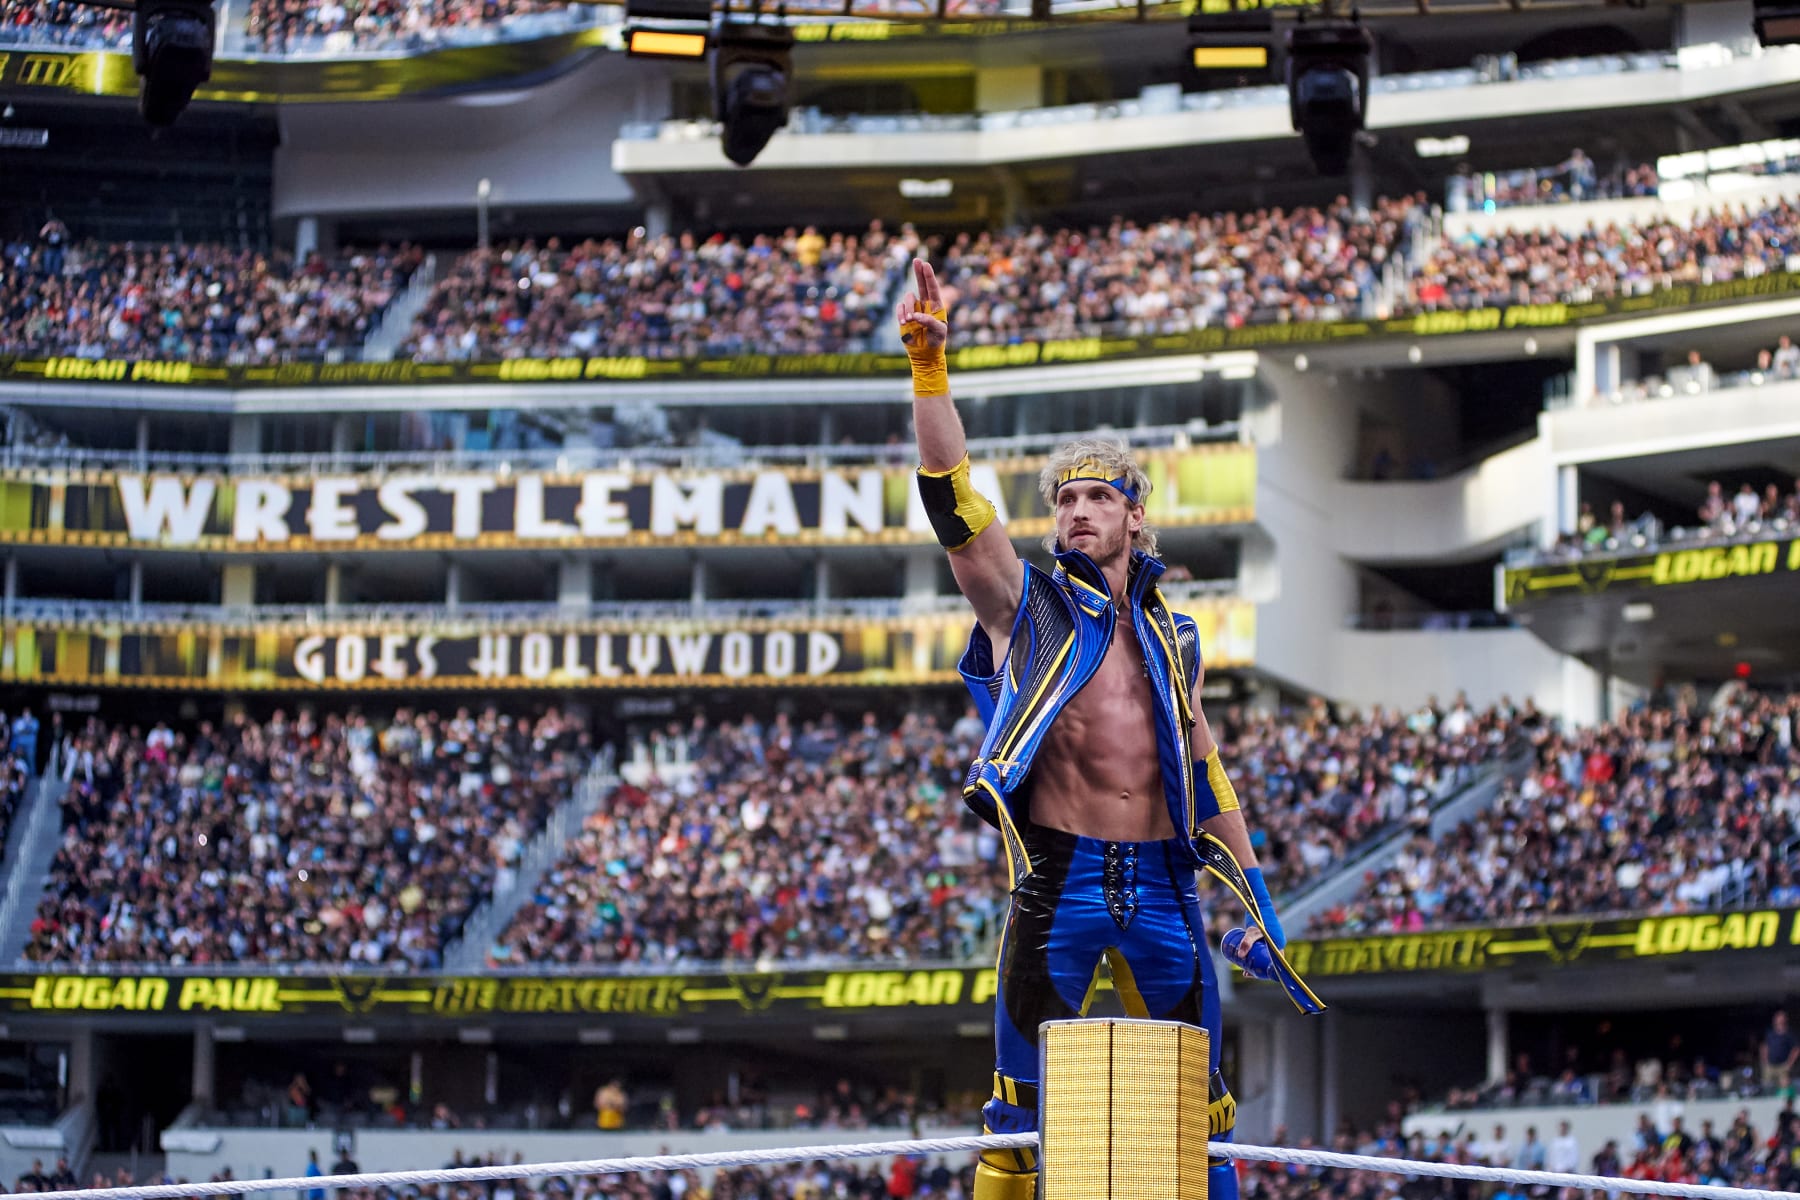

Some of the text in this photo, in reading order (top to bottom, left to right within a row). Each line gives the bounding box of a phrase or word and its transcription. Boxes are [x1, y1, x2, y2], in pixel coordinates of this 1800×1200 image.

[1652, 541, 1779, 585] LOGAN
[294, 630, 840, 684] GOES HOLLYWOOD
[1634, 909, 1780, 957] LOGAN
[31, 976, 168, 1010] LOGAN
[178, 977, 283, 1012] PAUL
[823, 970, 964, 1007] LOGAN
